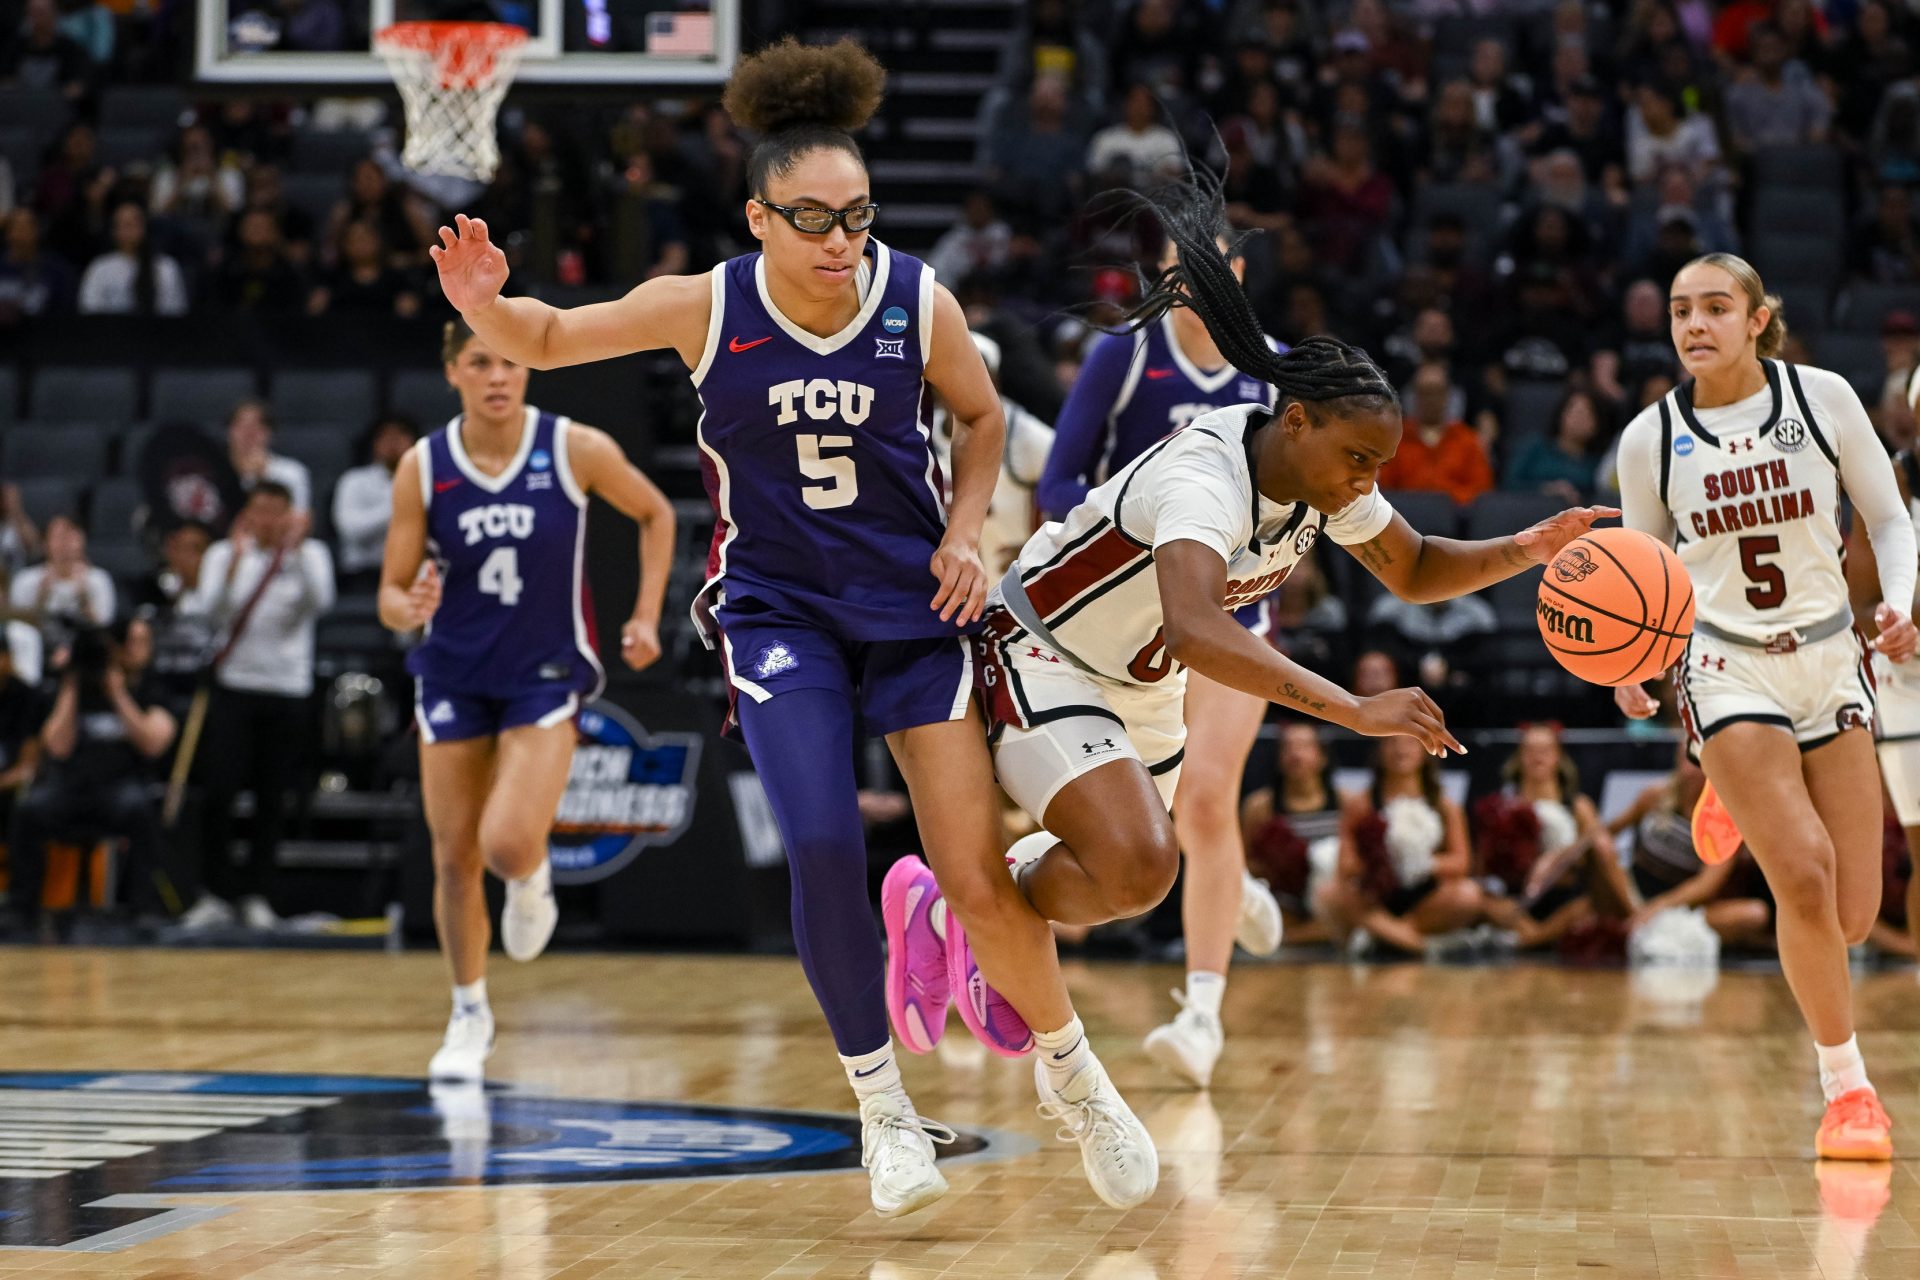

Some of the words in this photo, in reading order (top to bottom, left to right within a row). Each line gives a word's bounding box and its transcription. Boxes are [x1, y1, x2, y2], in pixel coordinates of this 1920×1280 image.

[885, 319, 907, 327] NCAA
[769, 378, 875, 426] TCU
[1777, 420, 1802, 445] SEC
[796, 434, 859, 510] 5
[1703, 458, 1790, 501] SOUTH
[457, 503, 536, 547] TCU
[1690, 488, 1815, 539] CAROLINA
[1296, 527, 1317, 554] SEC
[477, 546, 524, 606] 4
[1738, 534, 1787, 611] 5
[1537, 598, 1595, 643] Wilso
